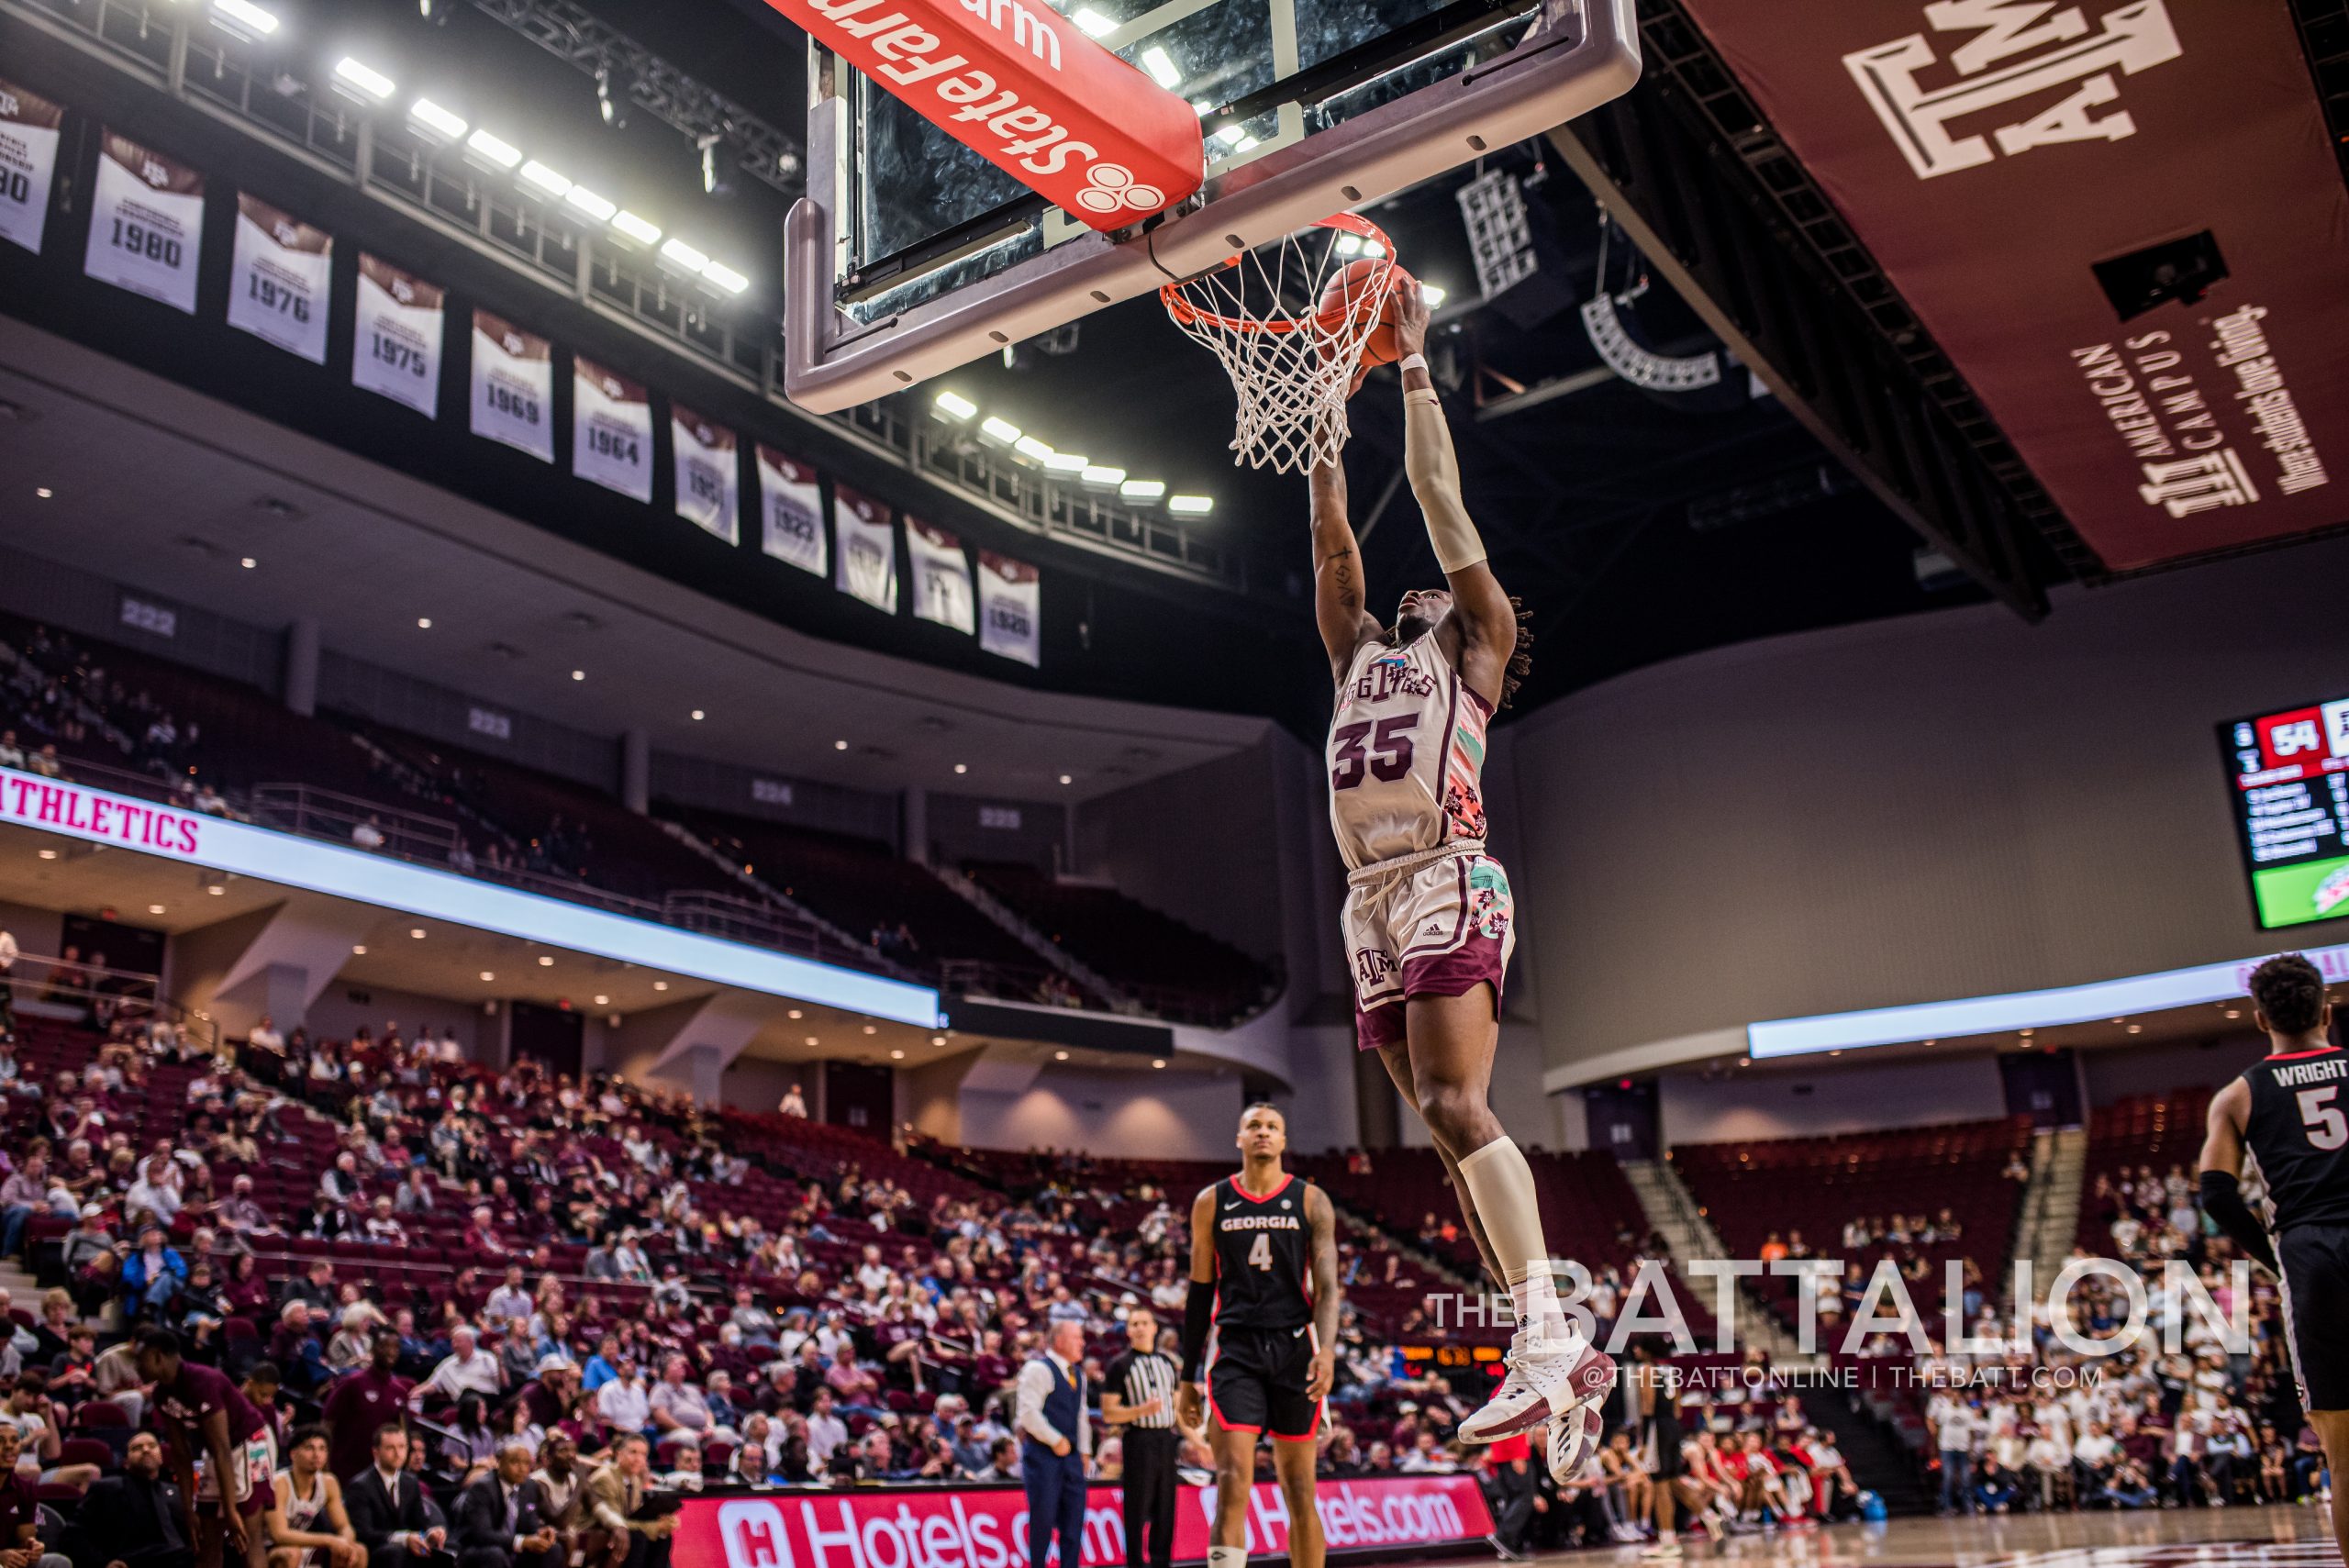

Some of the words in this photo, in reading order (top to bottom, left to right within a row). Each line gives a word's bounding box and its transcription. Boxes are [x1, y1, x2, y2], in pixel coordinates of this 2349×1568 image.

[110, 218, 182, 270] 1980
[249, 273, 311, 324] 1976
[372, 332, 427, 377] 1975
[486, 384, 540, 426] 1969
[2070, 343, 2176, 457] AMERICAN
[2125, 330, 2224, 450] CAMPUS
[588, 426, 640, 466] 1964
[1331, 712, 1419, 789] 35
[0, 776, 198, 854] THLETICS
[2273, 1059, 2348, 1087] WRIGHT
[2296, 1086, 2348, 1151] 5
[1220, 1216, 1300, 1231] GEORGIA
[1248, 1233, 1273, 1271] 4
[800, 1496, 1127, 1568] Hotels.cm
[1251, 1483, 1464, 1550] Htels.com
